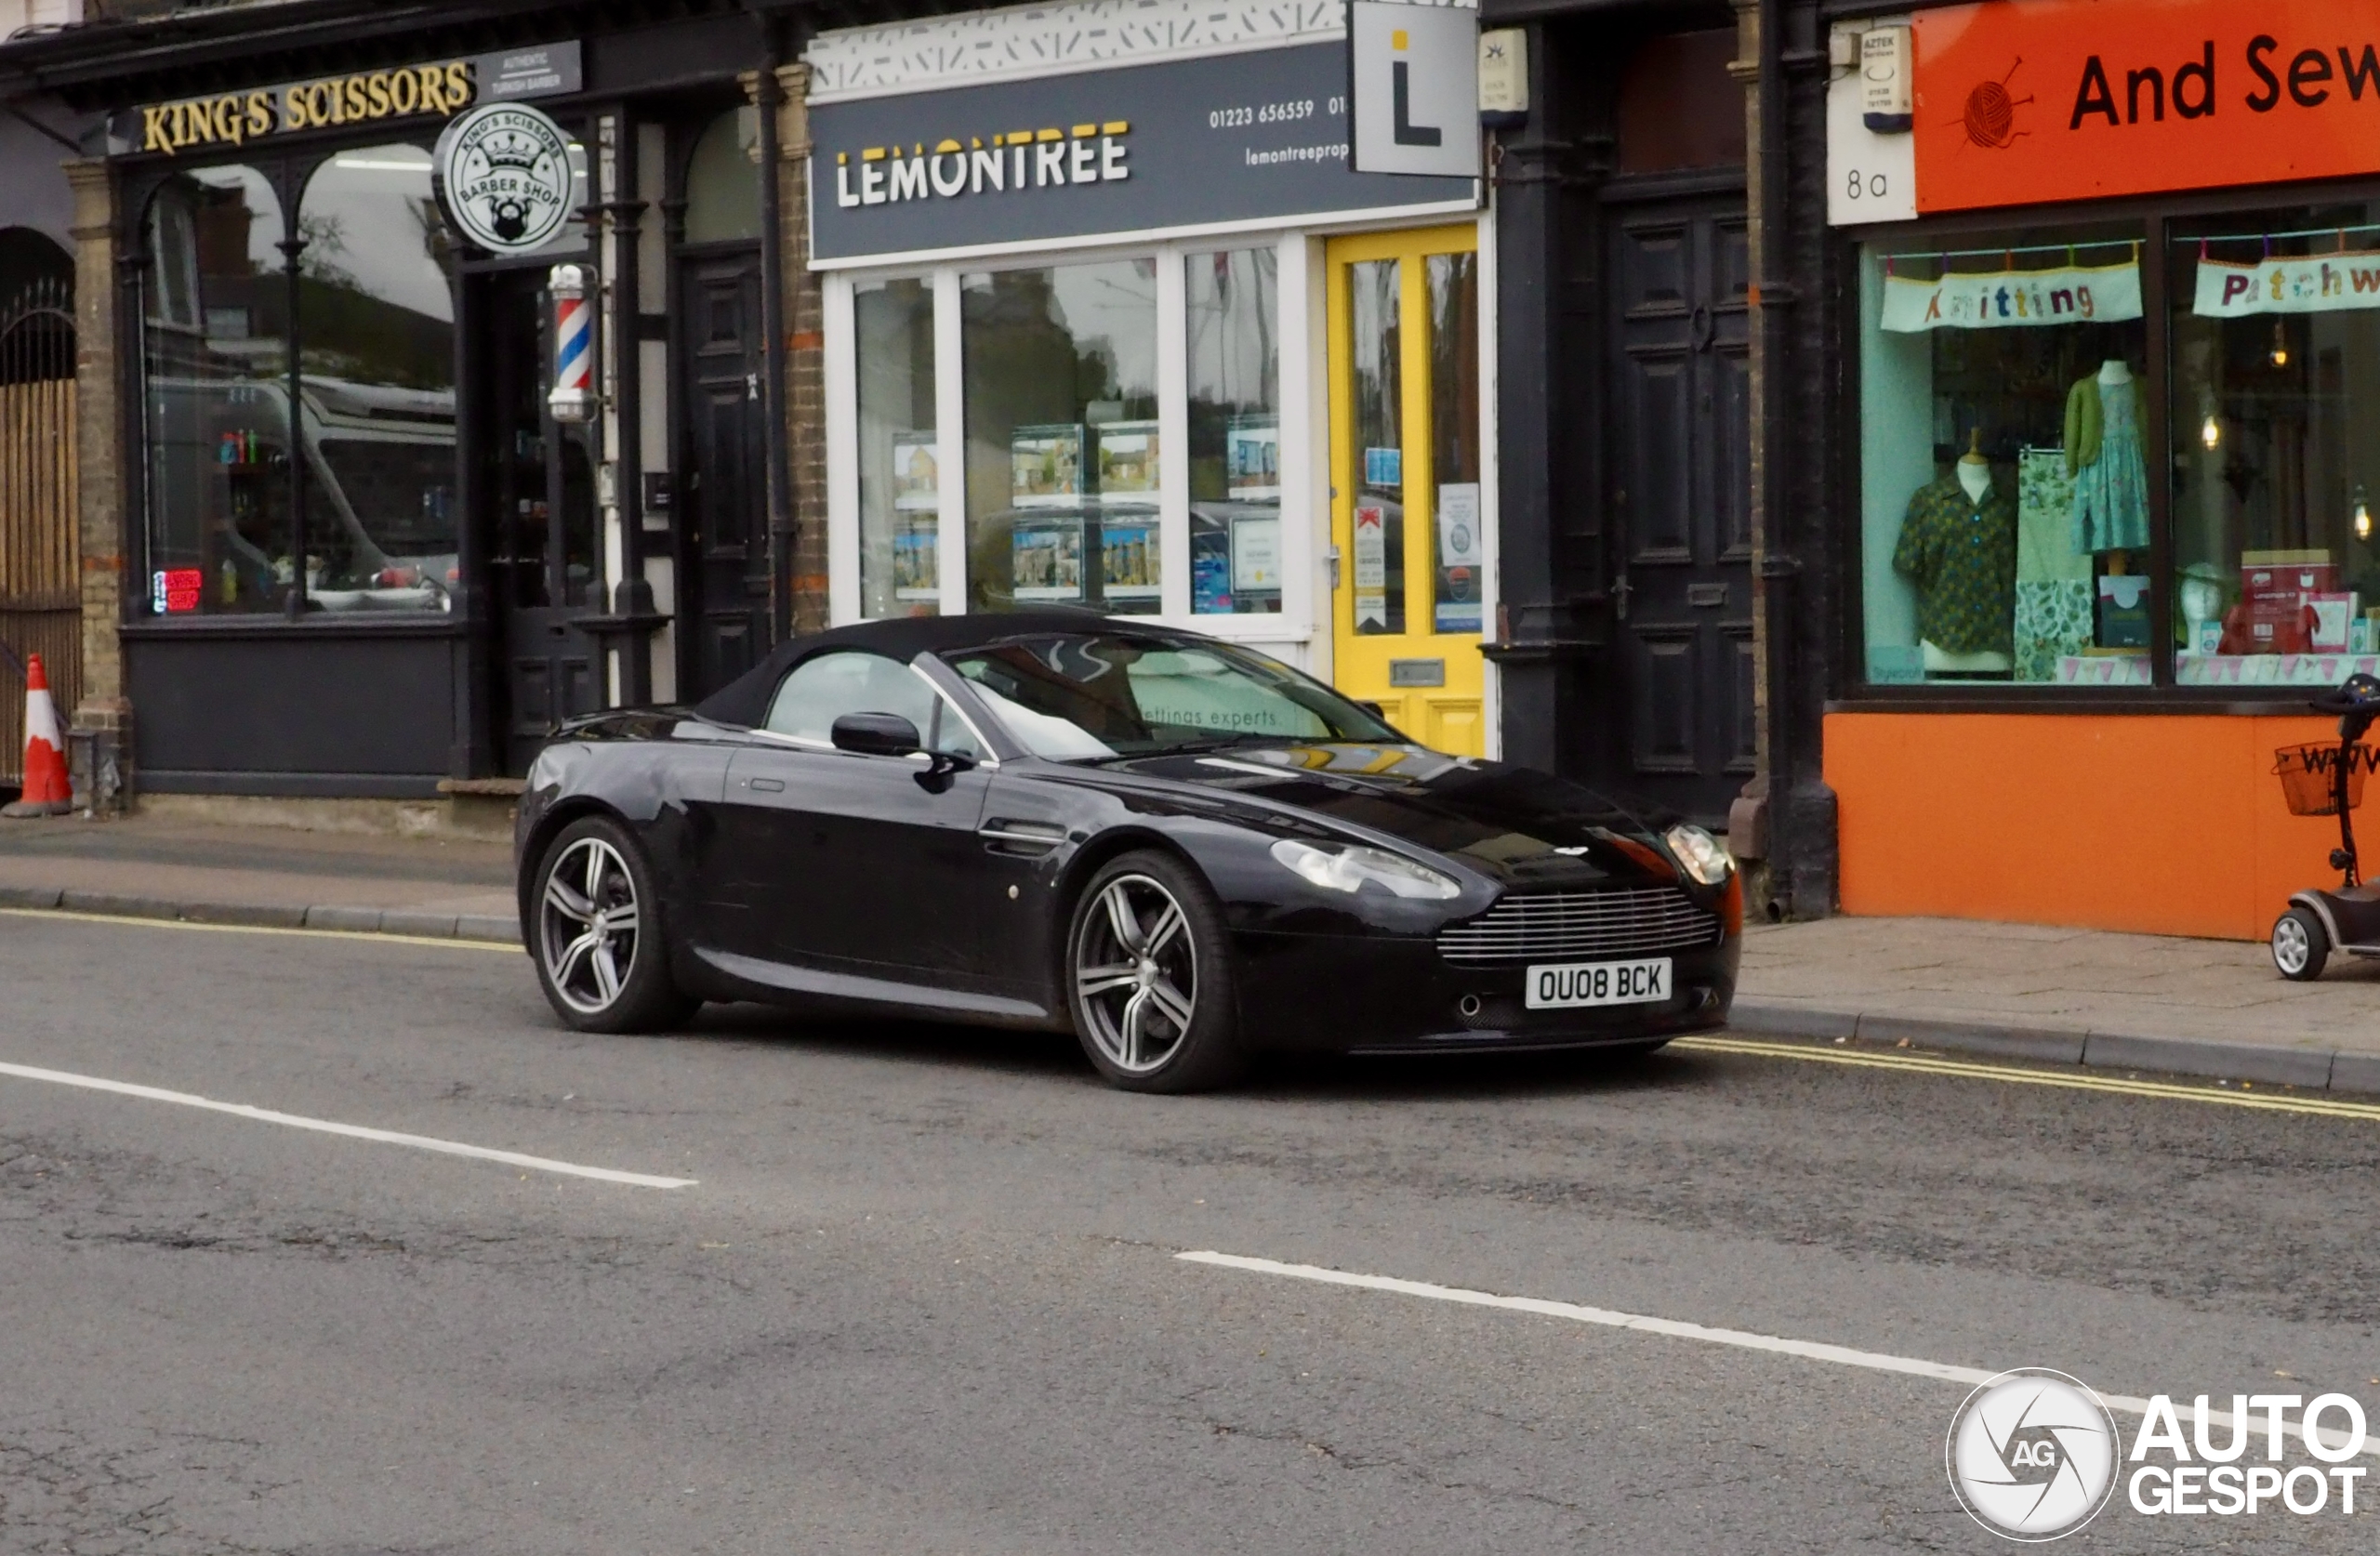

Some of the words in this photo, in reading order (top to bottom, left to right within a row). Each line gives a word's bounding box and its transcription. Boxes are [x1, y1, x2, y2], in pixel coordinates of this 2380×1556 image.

[286, 61, 469, 130] SCISSORS
[2069, 40, 2215, 130] And
[1210, 107, 1252, 128] 01223
[1258, 99, 1314, 123] 656559
[462, 116, 499, 152] KING'S
[504, 114, 562, 158] SCISSORS
[1246, 143, 1349, 165] lemontreeprop
[838, 121, 1128, 207] LEMONTREE
[459, 178, 518, 204] BARBER
[522, 180, 562, 206] SHOP
[1540, 969, 1607, 1001] OU08
[1617, 965, 1661, 996] BCK
